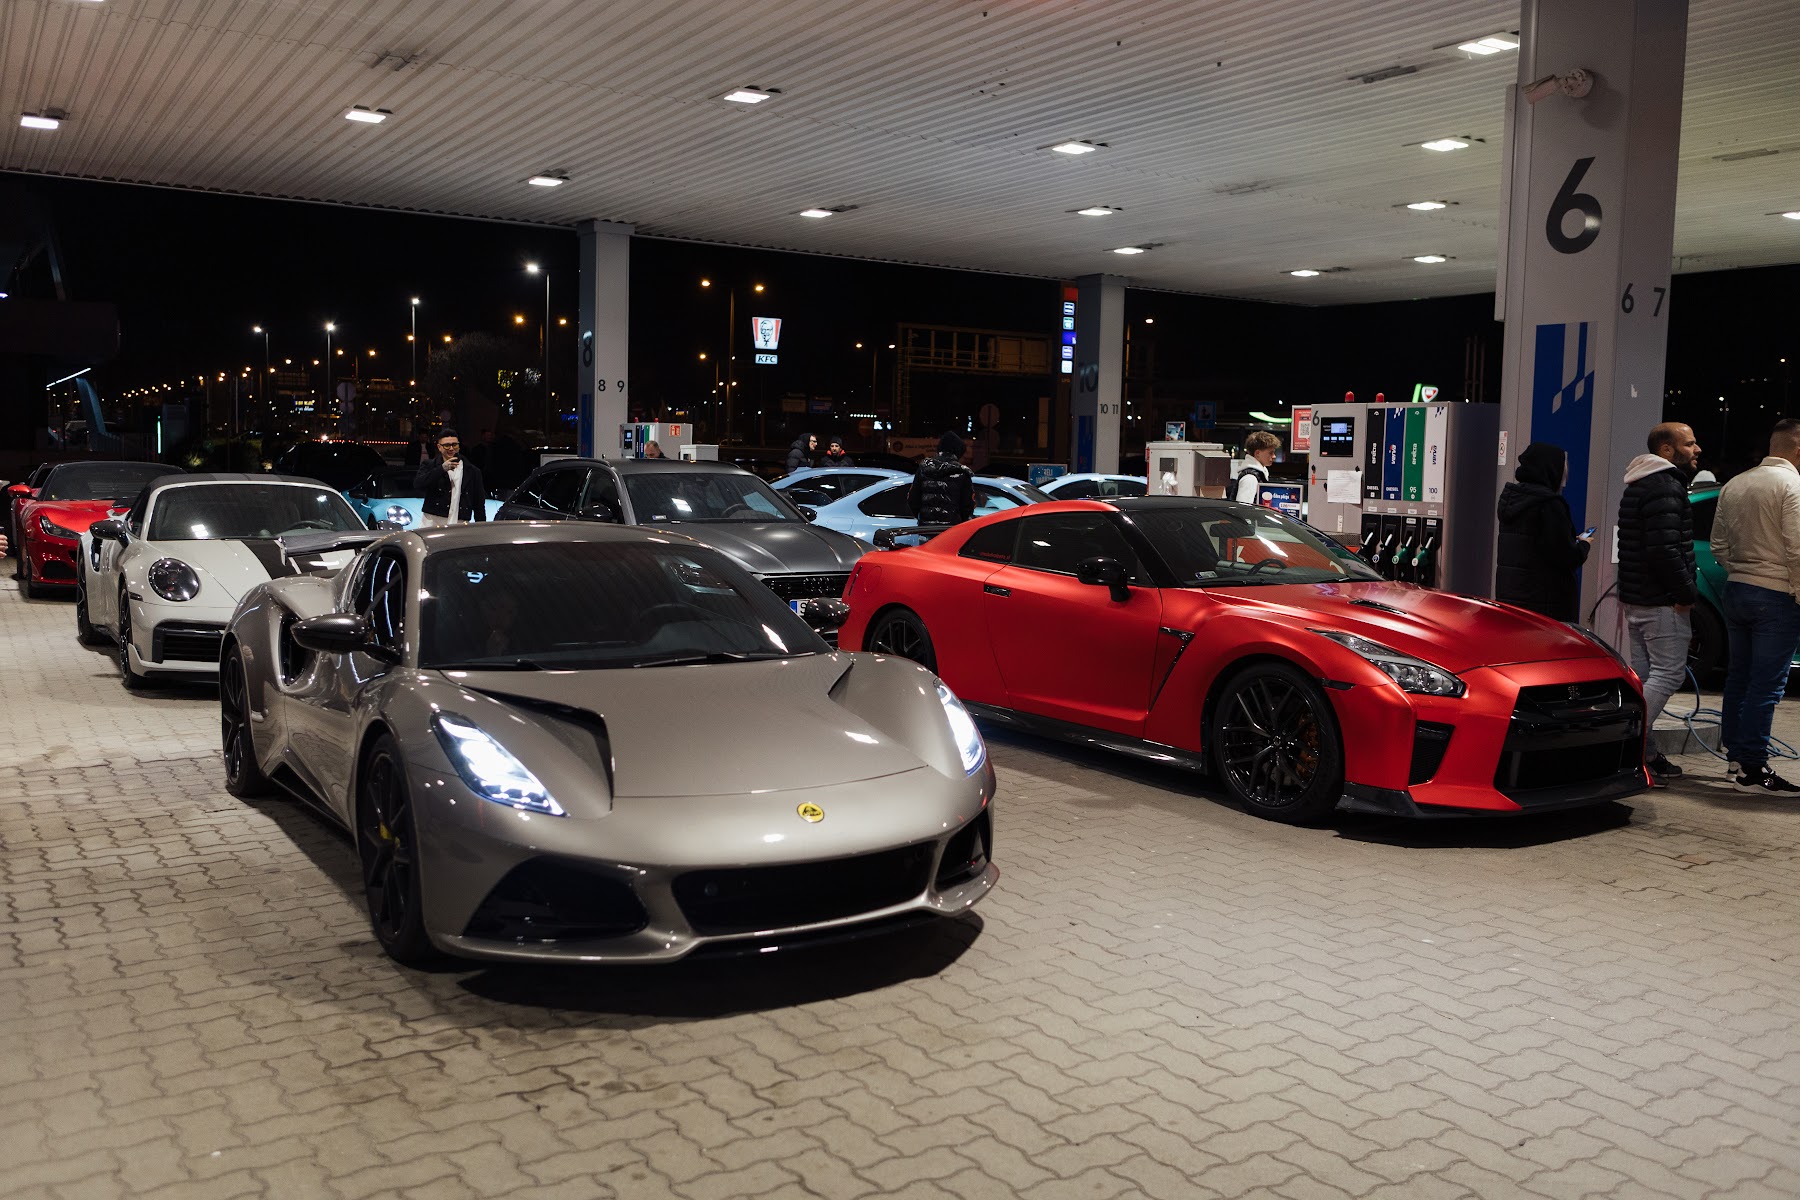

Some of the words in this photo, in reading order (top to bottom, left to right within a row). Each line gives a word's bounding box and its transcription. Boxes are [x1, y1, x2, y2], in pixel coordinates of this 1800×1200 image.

[1546, 156, 1603, 254] 6
[1621, 283, 1634, 314] 6
[1652, 287, 1666, 317] 7
[582, 330, 593, 368] 8
[757, 355, 776, 363] KFC
[598, 379, 606, 392] 8
[617, 380, 625, 392] 9
[1079, 363, 1098, 393] 10
[1100, 404, 1108, 414] 10
[1112, 405, 1118, 414] 11
[1312, 410, 1320, 426] 6
